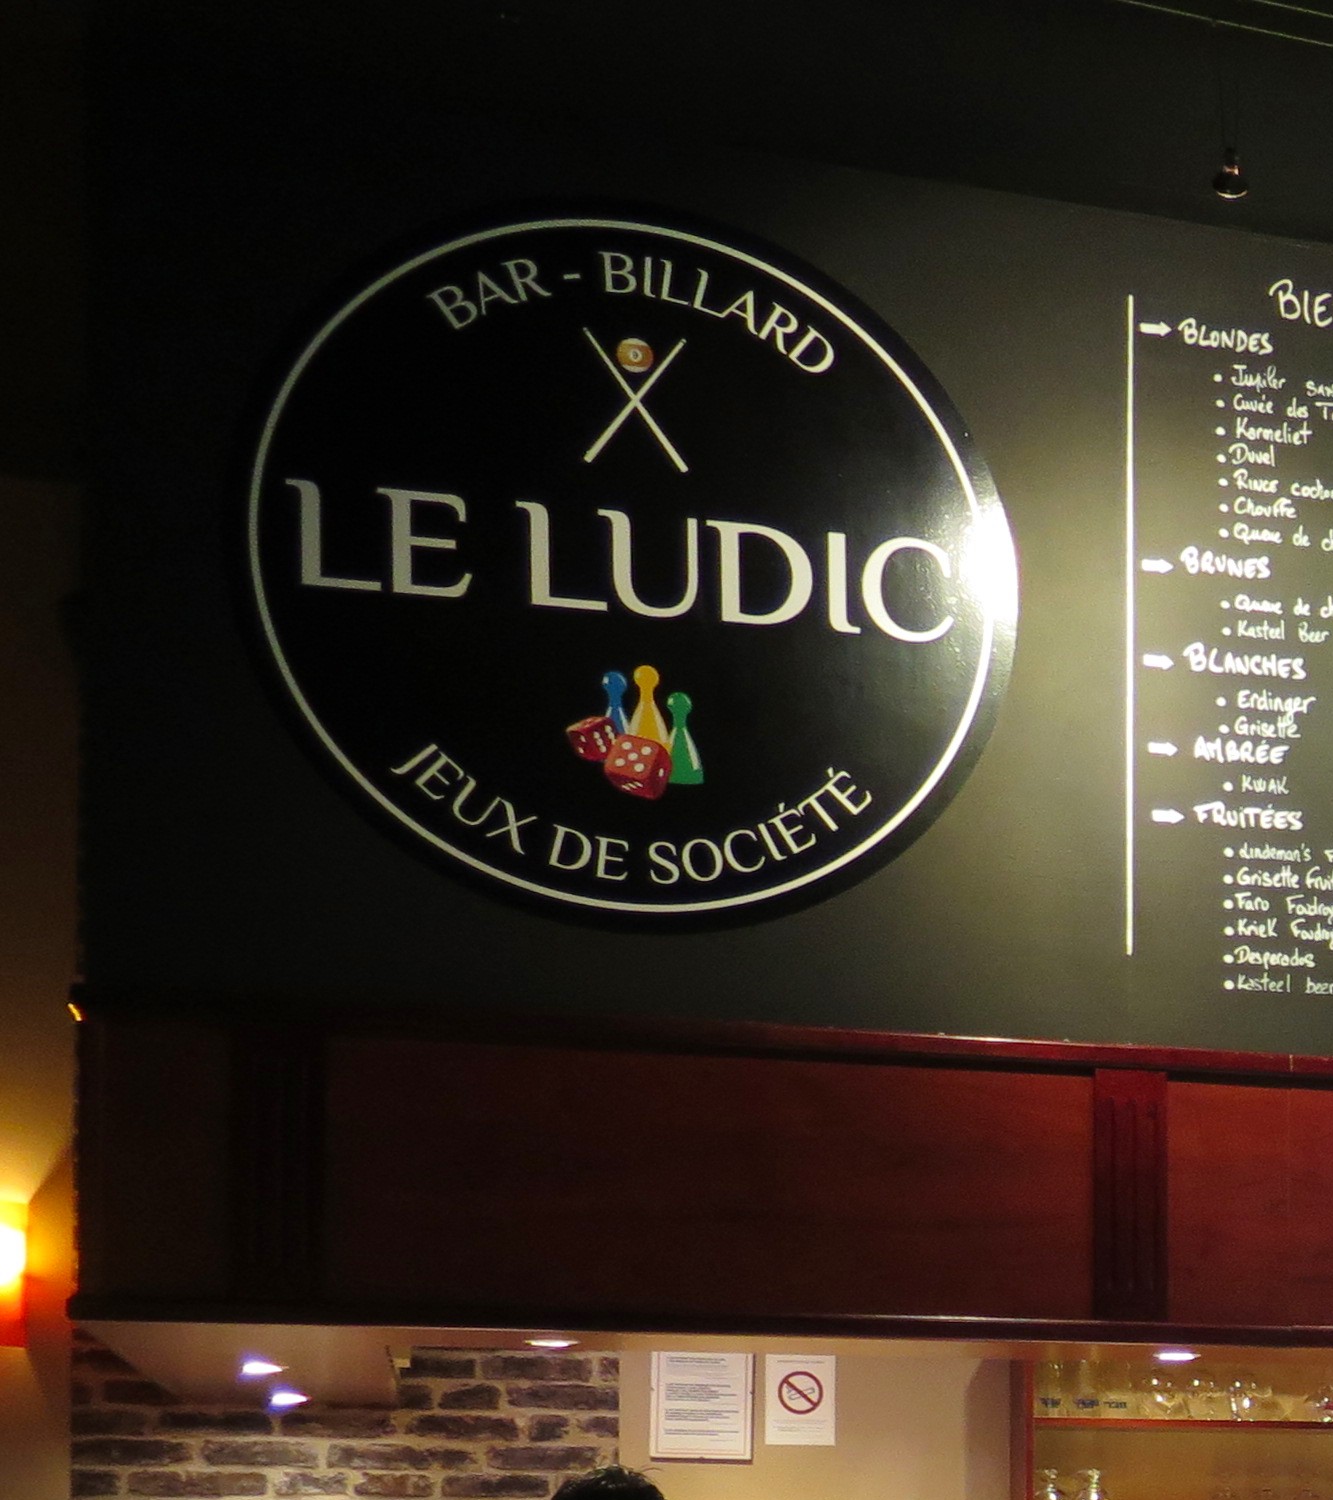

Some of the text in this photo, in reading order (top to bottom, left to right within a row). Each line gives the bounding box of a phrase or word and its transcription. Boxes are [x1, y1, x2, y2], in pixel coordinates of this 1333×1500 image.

[426, 256, 552, 331] BAR
[599, 250, 835, 375] BILLARD
[1178, 318, 1274, 356] BLONDES
[1231, 364, 1286, 393] Jupiler
[1287, 397, 1309, 419] des
[1228, 442, 1275, 467] Duvel
[1292, 525, 1310, 547] de
[285, 477, 957, 644] LE LUDIC
[1180, 545, 1271, 579] BRUNES
[1293, 597, 1311, 617] de
[1237, 619, 1330, 644] Kasteel Beer
[1183, 641, 1307, 681] BLANCHES
[1236, 689, 1317, 715] Erdinger
[1234, 714, 1302, 739] Grisette
[1194, 738, 1291, 765] AMBRÉE
[392, 742, 873, 886] JEUX DE SOCIÉTÉ
[1236, 865, 1299, 889] Grisette
[1234, 892, 1270, 911] Faro
[1234, 945, 1316, 970] Desperados
[1236, 972, 1291, 993] Kasteel
